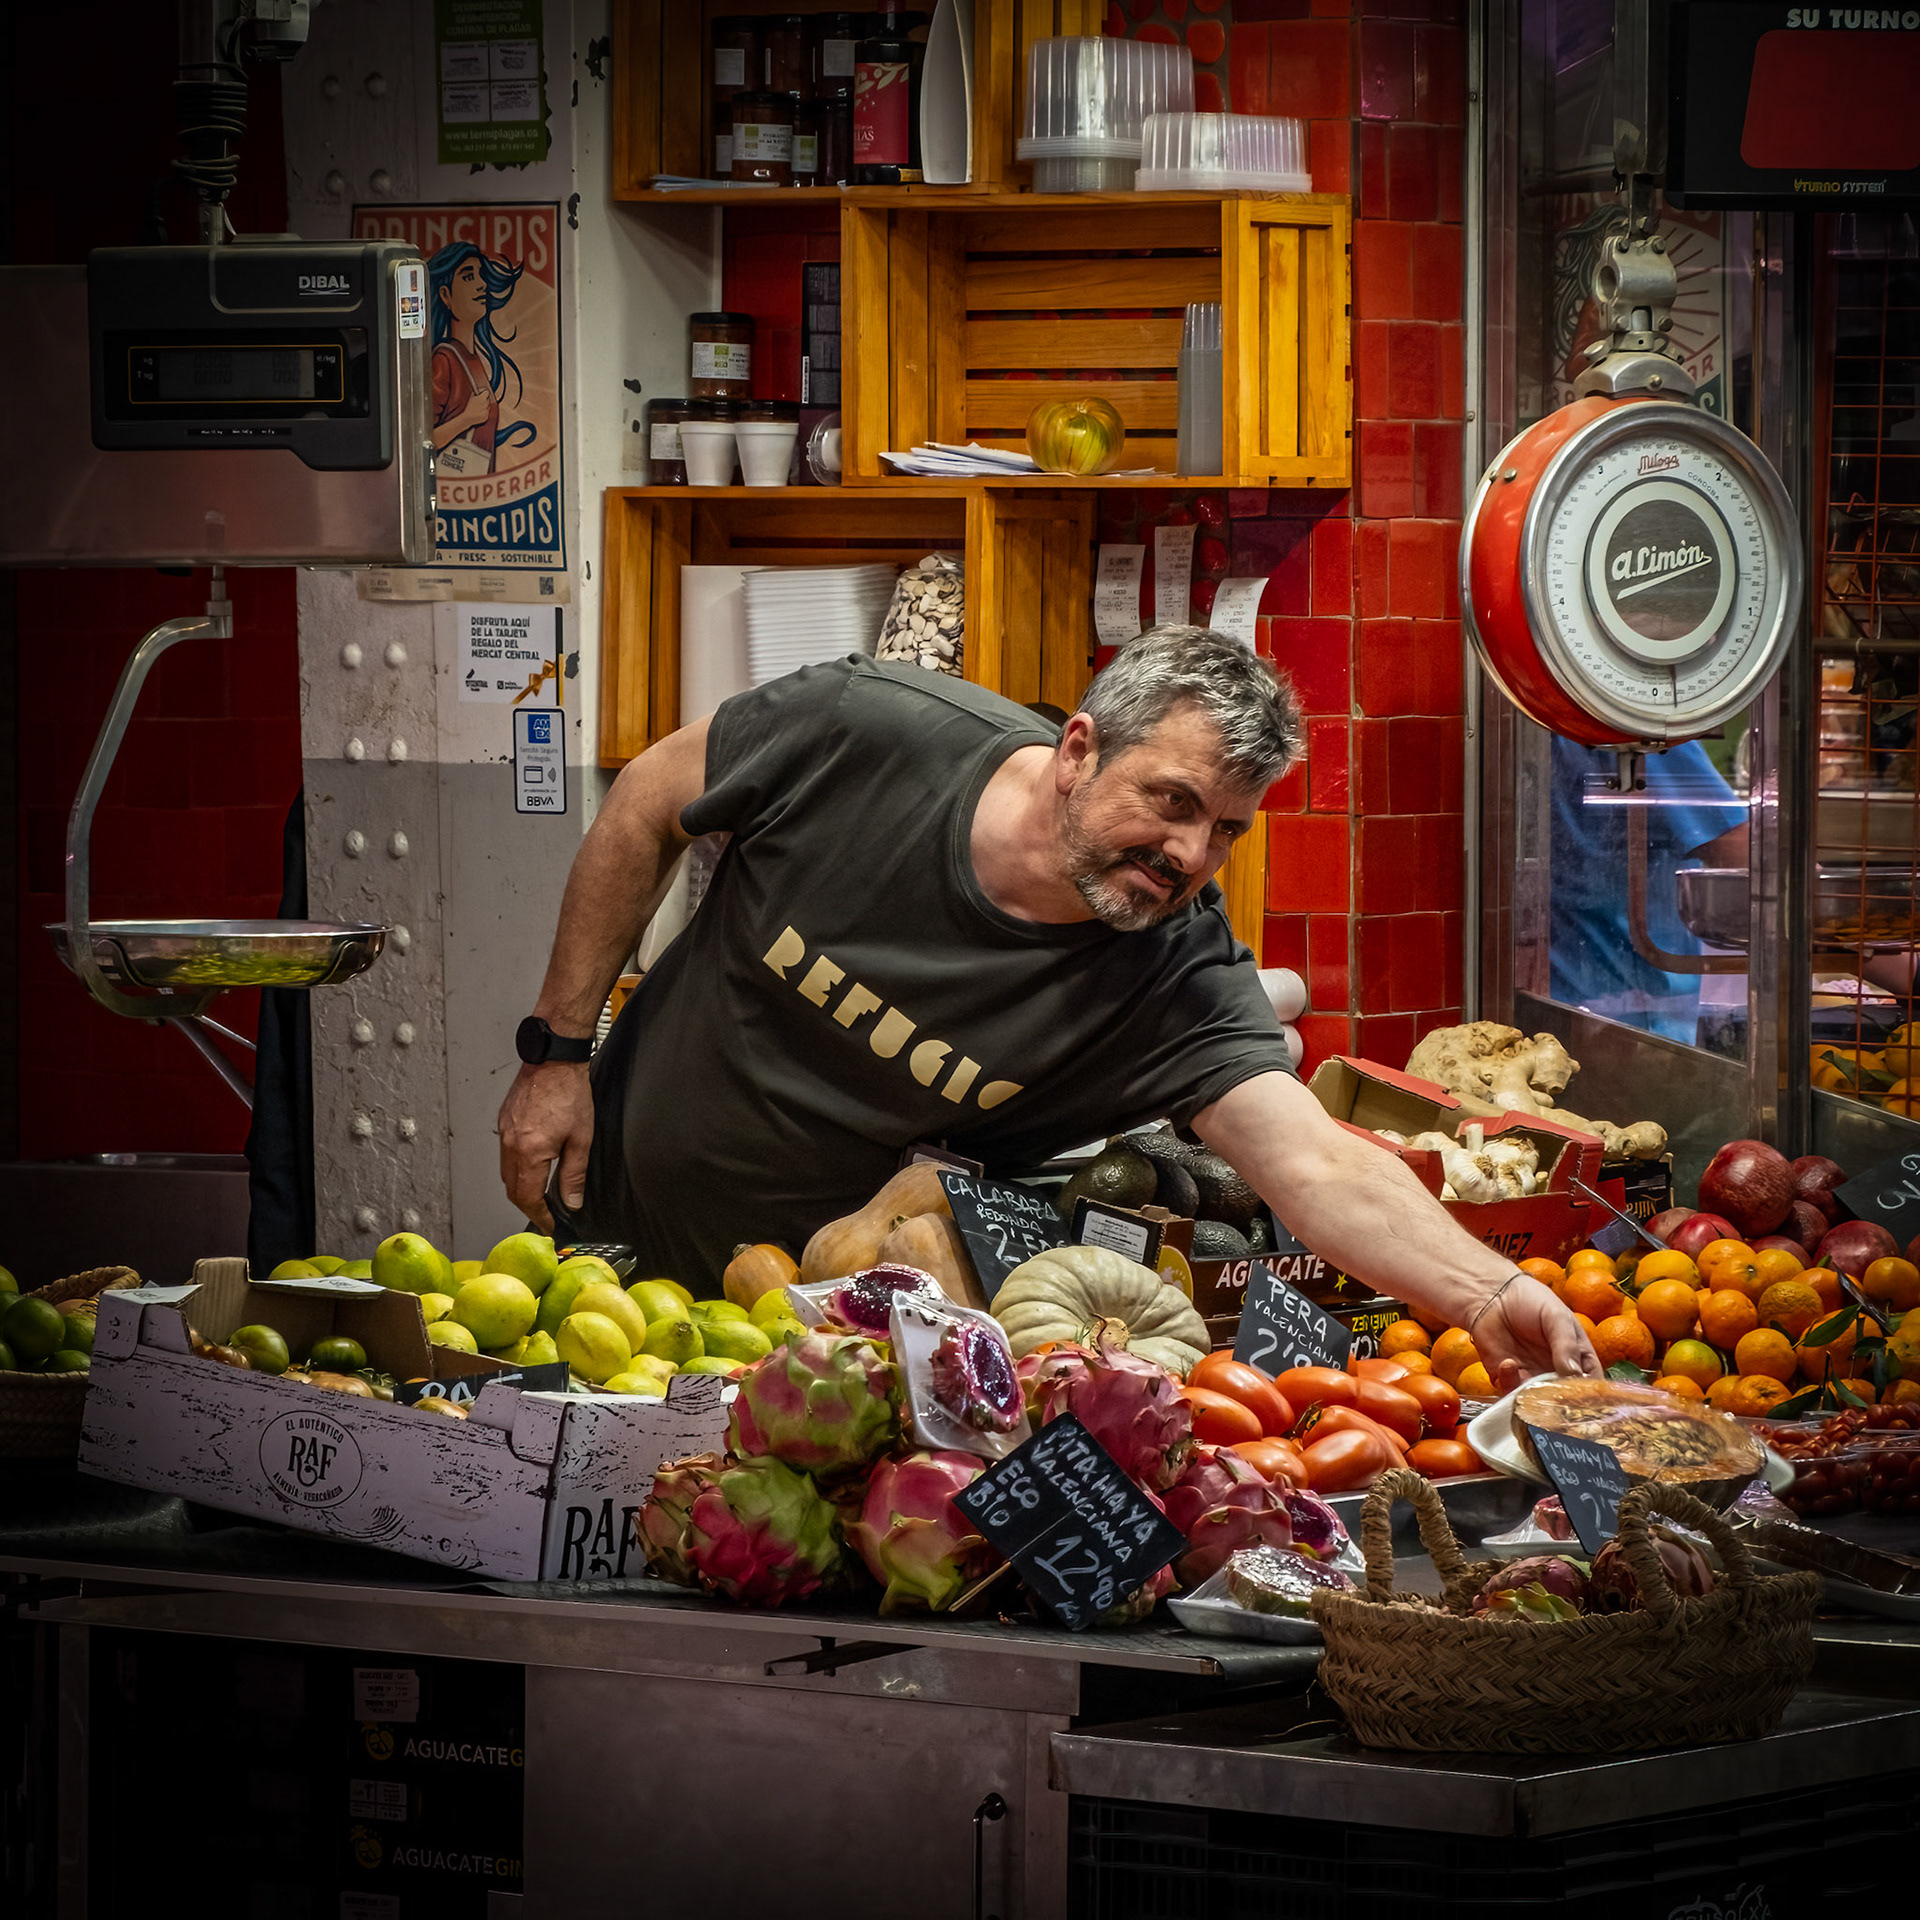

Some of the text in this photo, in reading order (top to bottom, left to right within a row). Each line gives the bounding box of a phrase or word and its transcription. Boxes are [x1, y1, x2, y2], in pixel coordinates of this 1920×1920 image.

[1787, 8, 1920, 29] SU TURNO
[299, 275, 350, 291] DIBAL
[439, 461, 551, 503] ECUPERAR
[1715, 472, 1722, 481] 2
[435, 497, 553, 544] RINCIPIS
[501, 553, 553, 563] SOSTENIBLE
[471, 616, 530, 628] DISFRUTA AQUÍ
[471, 627, 527, 638] DE LA TARJETA
[471, 638, 519, 649] REGALO DEL
[471, 650, 540, 661] MERCAT CENTRAL
[1652, 687, 1658, 697] 0
[527, 796, 554, 807] BBVA
[1267, 1275, 1327, 1342] PERA
[286, 1417, 344, 1443] EL AUTÉNTICO
[288, 1436, 337, 1487] RAF
[273, 1472, 299, 1498] ALMERÍA
[403, 1738, 524, 1768] AGUACATEG
